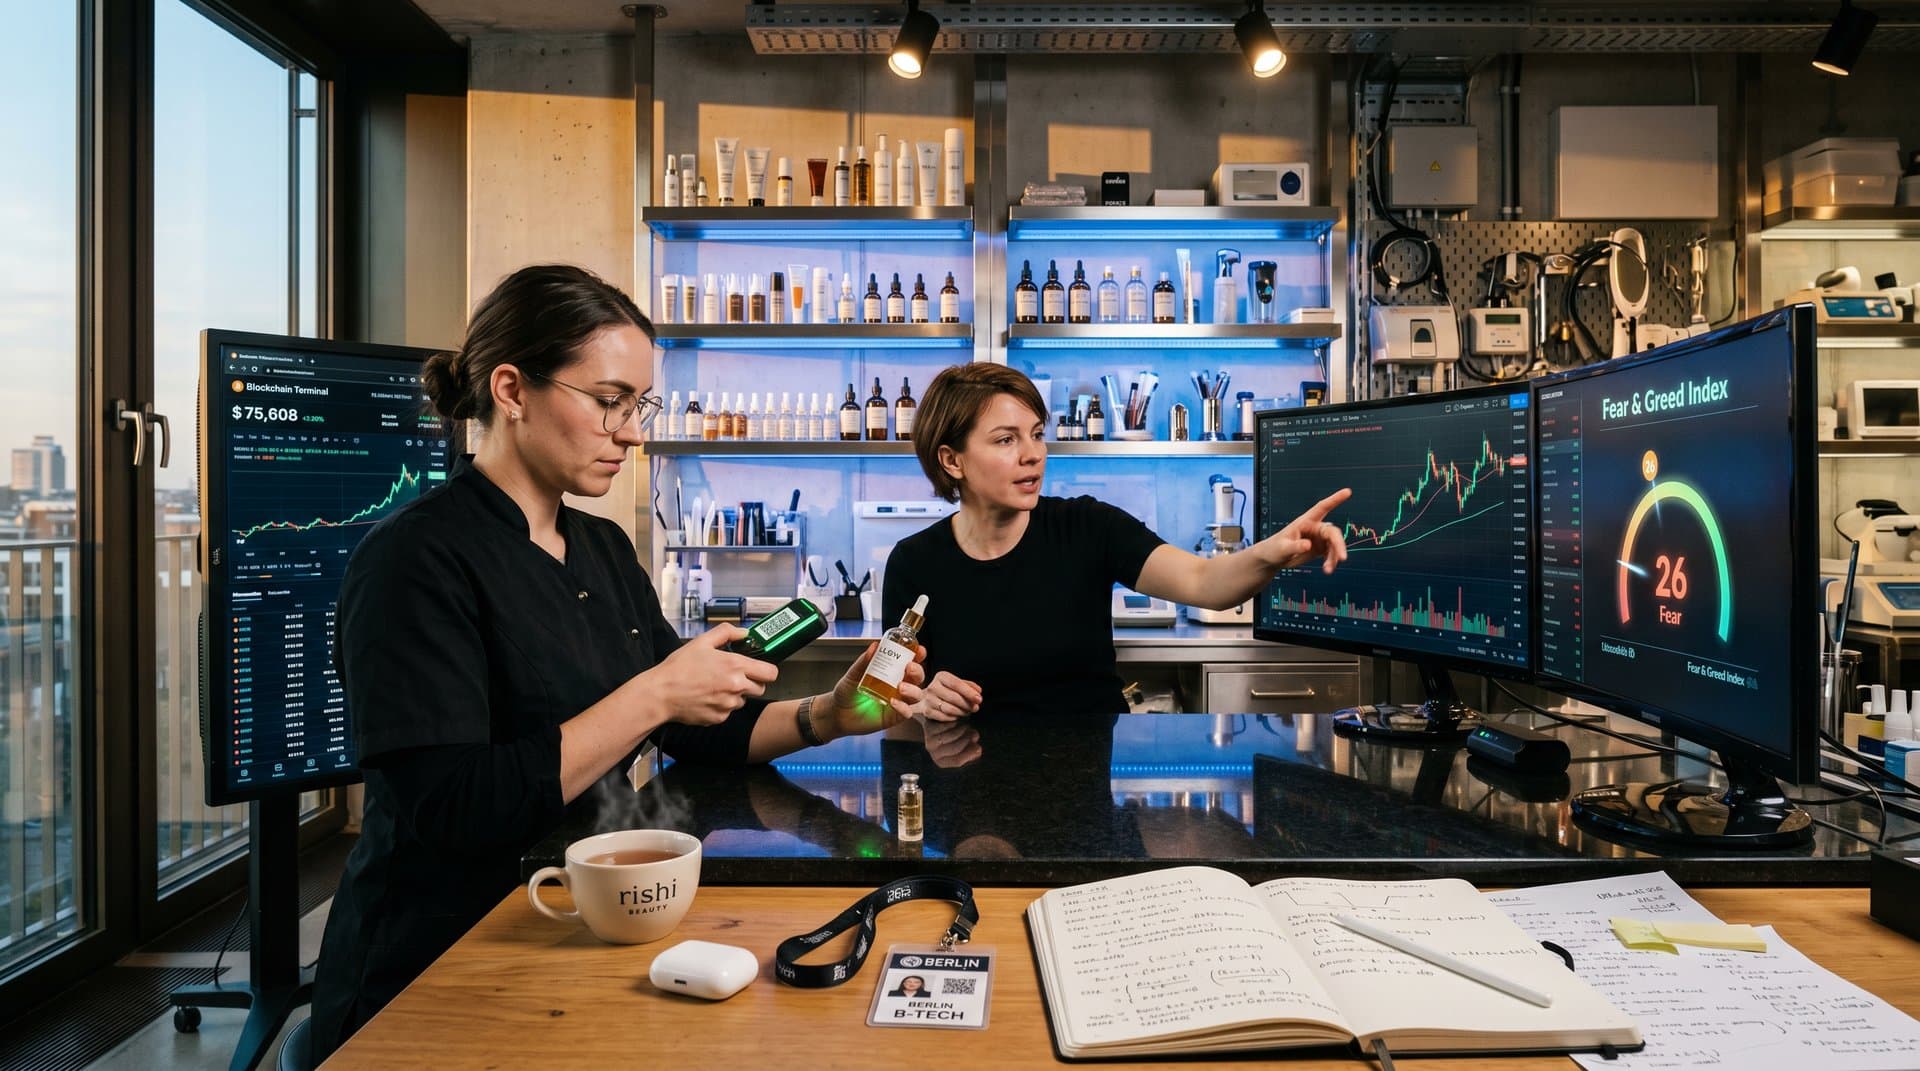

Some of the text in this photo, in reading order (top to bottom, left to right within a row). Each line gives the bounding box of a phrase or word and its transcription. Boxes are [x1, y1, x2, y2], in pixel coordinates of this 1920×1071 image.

[246, 382, 329, 395] Blockchain Terminal
[1602, 376, 1729, 420] Fear & Greed Index
[1645, 460, 1656, 474] 26
[1655, 555, 1688, 600] 26
[1659, 604, 1683, 625] Fear
[1687, 661, 1701, 674] Fear
[1726, 671, 1745, 686] Index
[619, 878, 677, 905] rishi
[628, 904, 668, 915] BEAUTY
[924, 957, 980, 970] BERLIN
[908, 1001, 953, 1009] BERLIN
[894, 1009, 964, 1020] B-TECH
